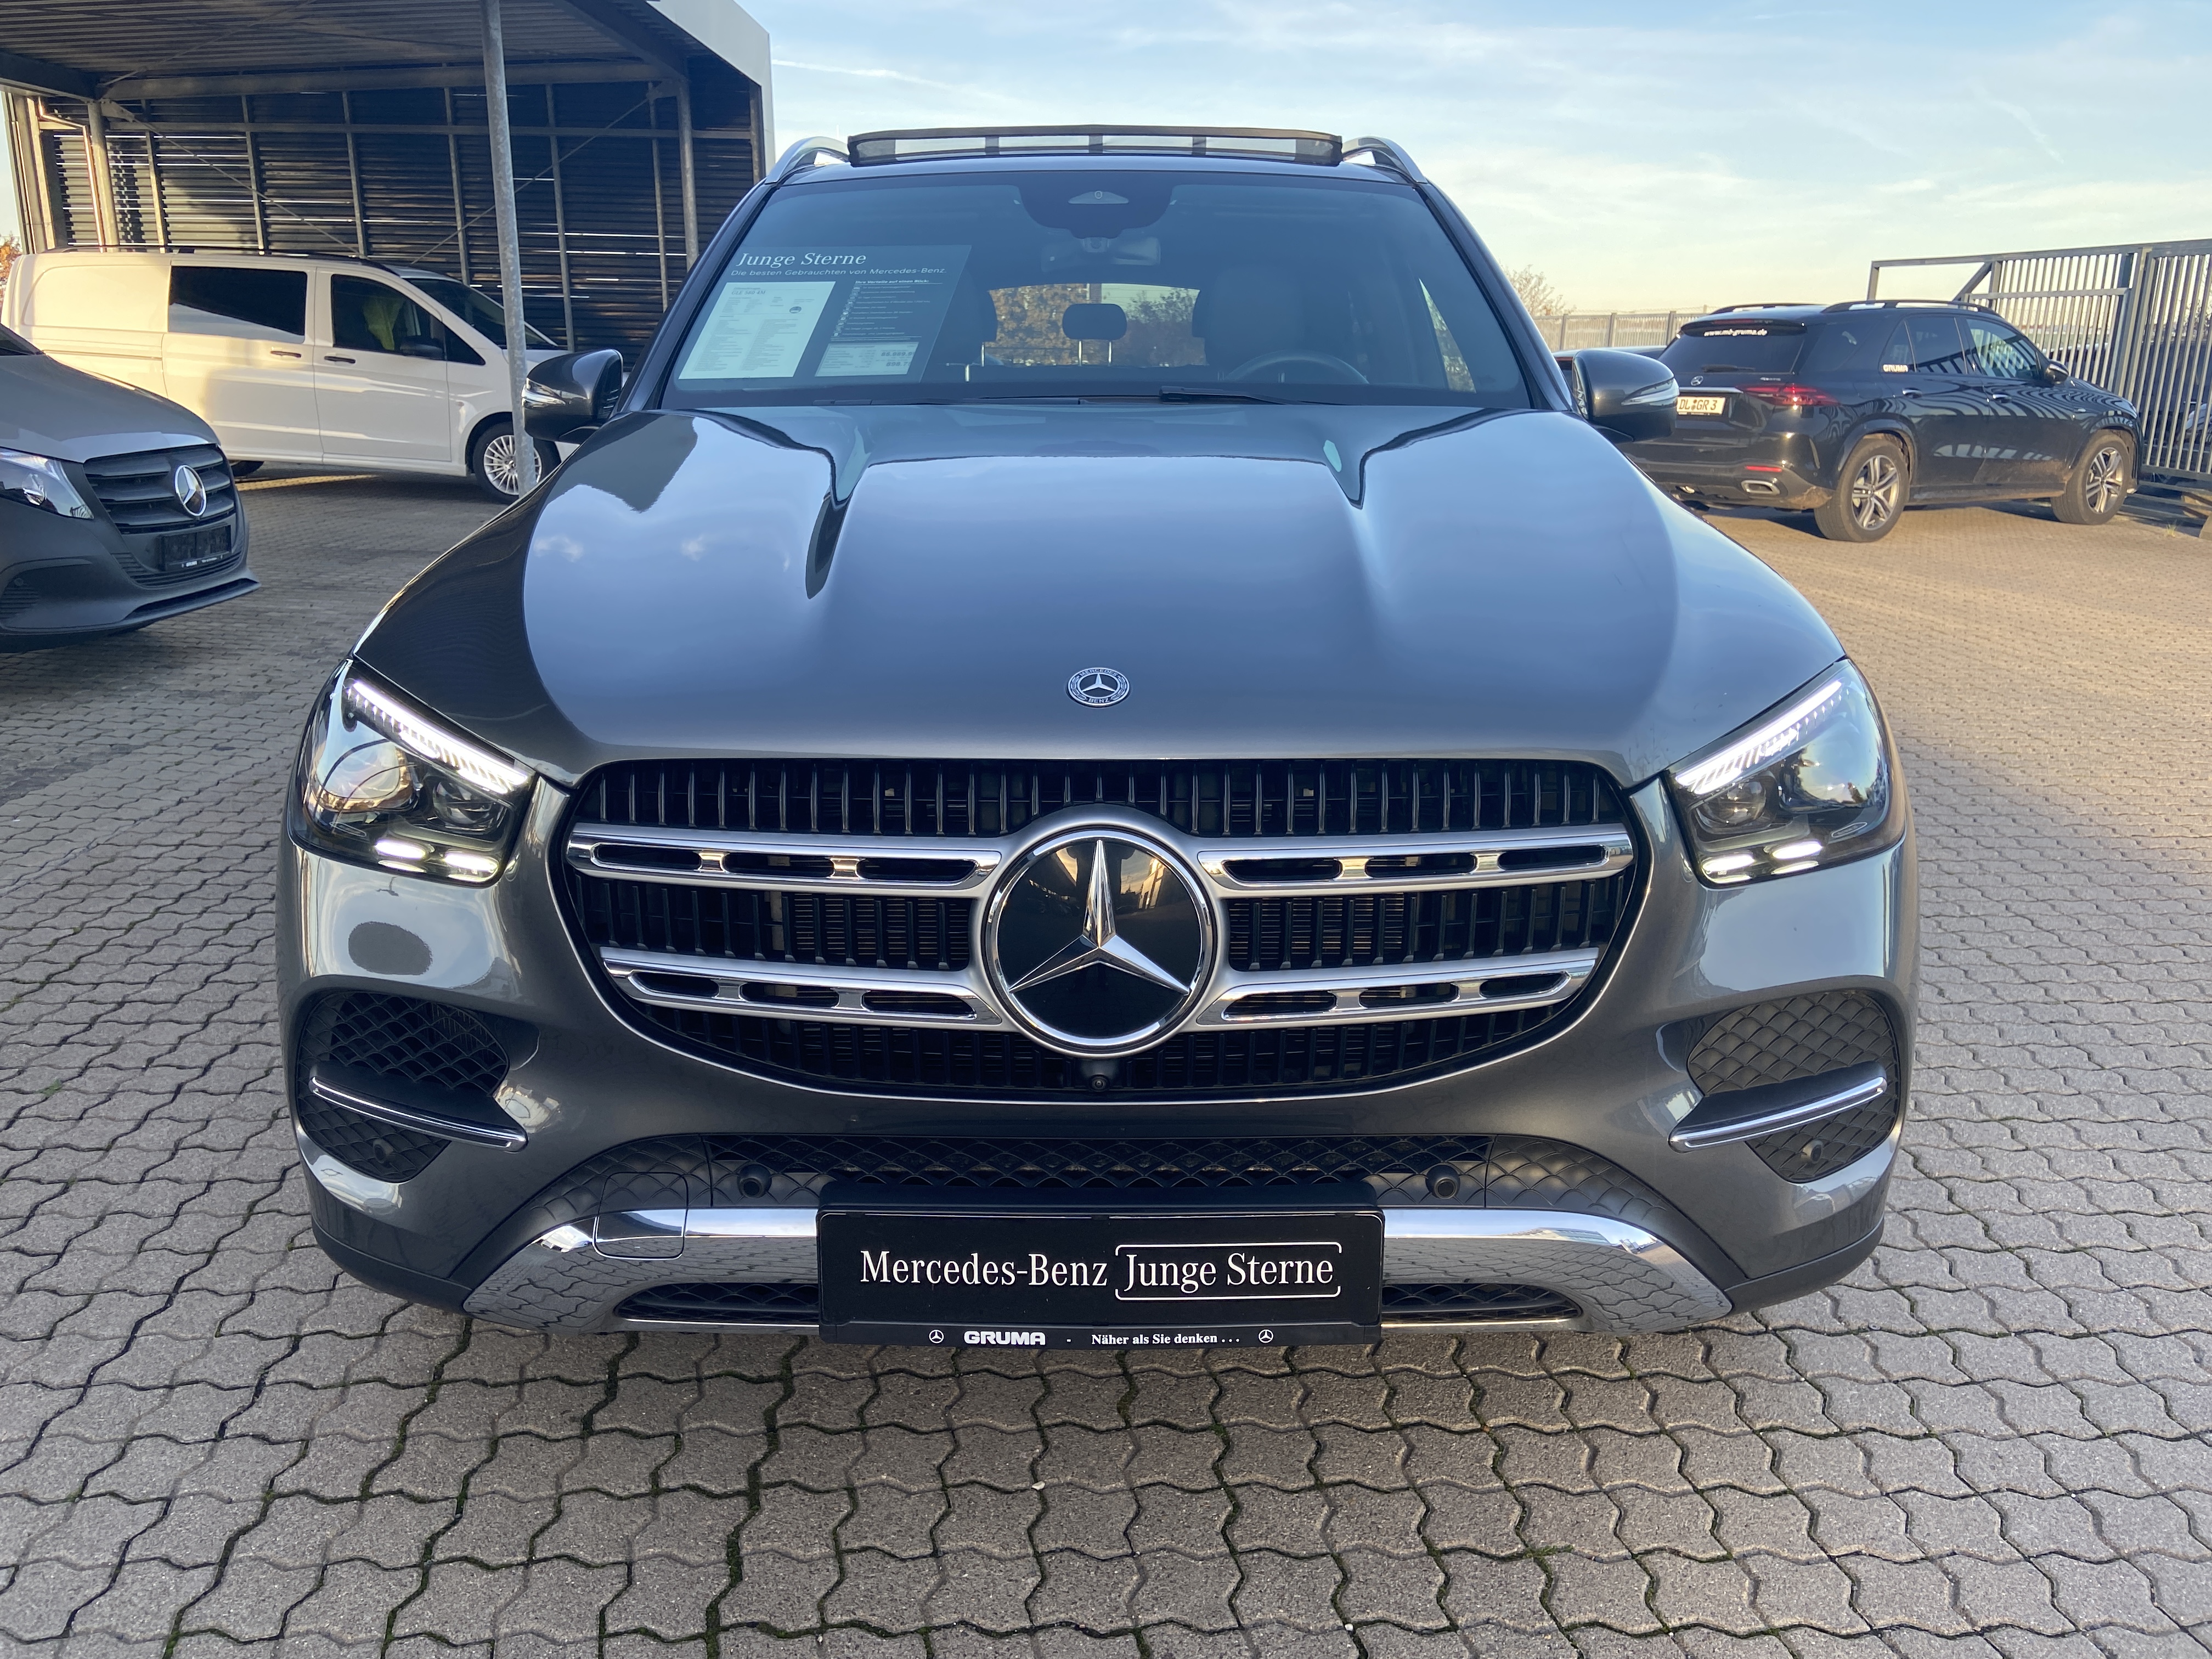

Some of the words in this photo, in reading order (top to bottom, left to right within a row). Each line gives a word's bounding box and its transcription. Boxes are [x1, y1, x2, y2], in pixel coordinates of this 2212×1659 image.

[736, 253, 795, 268] Junge
[800, 252, 866, 265] Sterne
[1883, 364, 1908, 373] GRUMA
[1679, 399, 1690, 410] DL
[1696, 399, 1709, 410] GR
[1710, 399, 1718, 410] 3
[1079, 669, 1118, 677] MERCEDES
[860, 1250, 1108, 1286] Mercedes-Benz
[1124, 1254, 1216, 1294] Junge
[1227, 1252, 1334, 1285] Sterne
[963, 1330, 1046, 1345] GRUMA
[1091, 1334, 1129, 1345] Näher
[1132, 1334, 1149, 1344] als
[1152, 1334, 1171, 1344] Sie
[1173, 1333, 1217, 1344] denken
